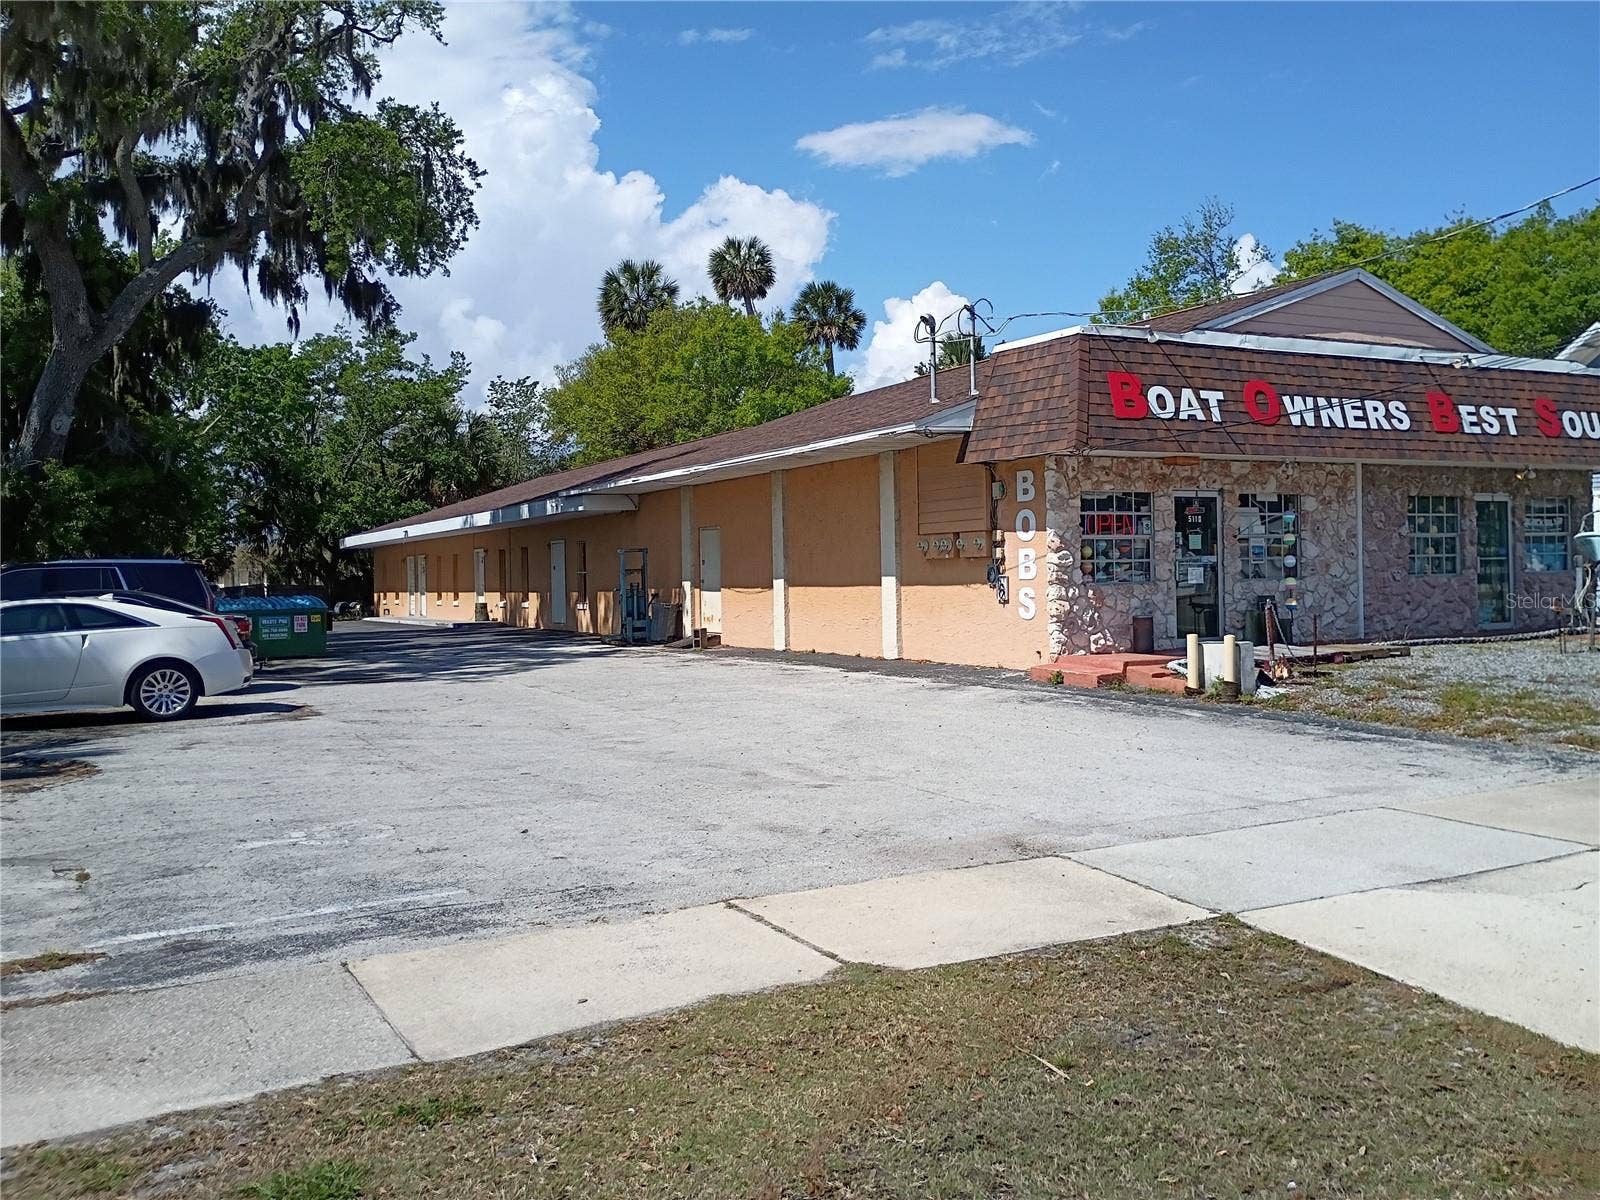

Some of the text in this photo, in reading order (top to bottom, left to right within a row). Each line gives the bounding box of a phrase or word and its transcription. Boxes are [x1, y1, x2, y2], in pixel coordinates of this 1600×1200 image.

[1105, 370, 1224, 423] BOAT
[1243, 379, 1411, 431] OWNERS
[1425, 389, 1518, 436] BEST
